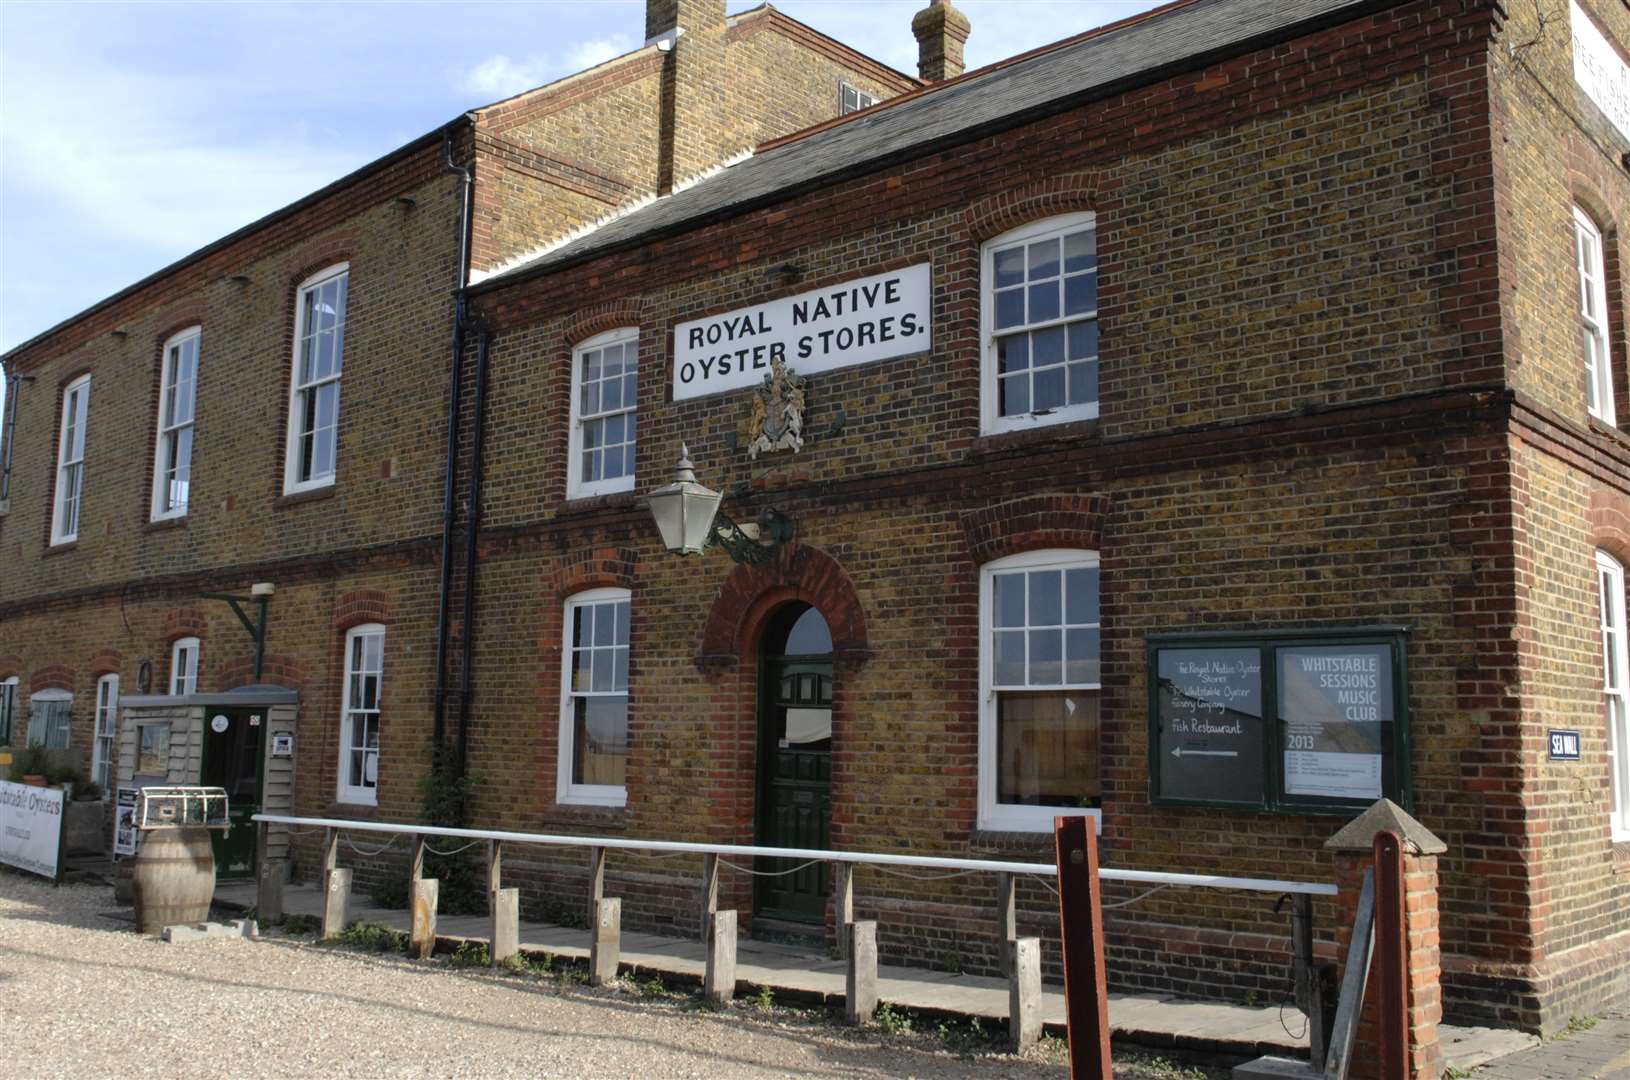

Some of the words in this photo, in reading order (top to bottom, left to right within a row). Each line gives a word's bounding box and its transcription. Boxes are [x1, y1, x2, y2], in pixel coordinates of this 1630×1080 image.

[689, 312, 772, 349] ROYAL
[793, 278, 900, 326] NATIVE
[680, 342, 786, 383] OYSTER
[798, 313, 924, 358] STORES.
[1302, 657, 1376, 672] WHITSTABLE
[1320, 674, 1377, 688] SESSIONS
[1223, 686, 1251, 702] Oyster
[1338, 690, 1377, 705] MUSIC
[1346, 706, 1377, 721] CLUB
[1172, 719, 1189, 733] Fish
[1191, 718, 1242, 734] Restaurant
[1288, 735, 1314, 749] 2013
[1552, 734, 1564, 755] SEA
[29, 792, 61, 816] Oysters
